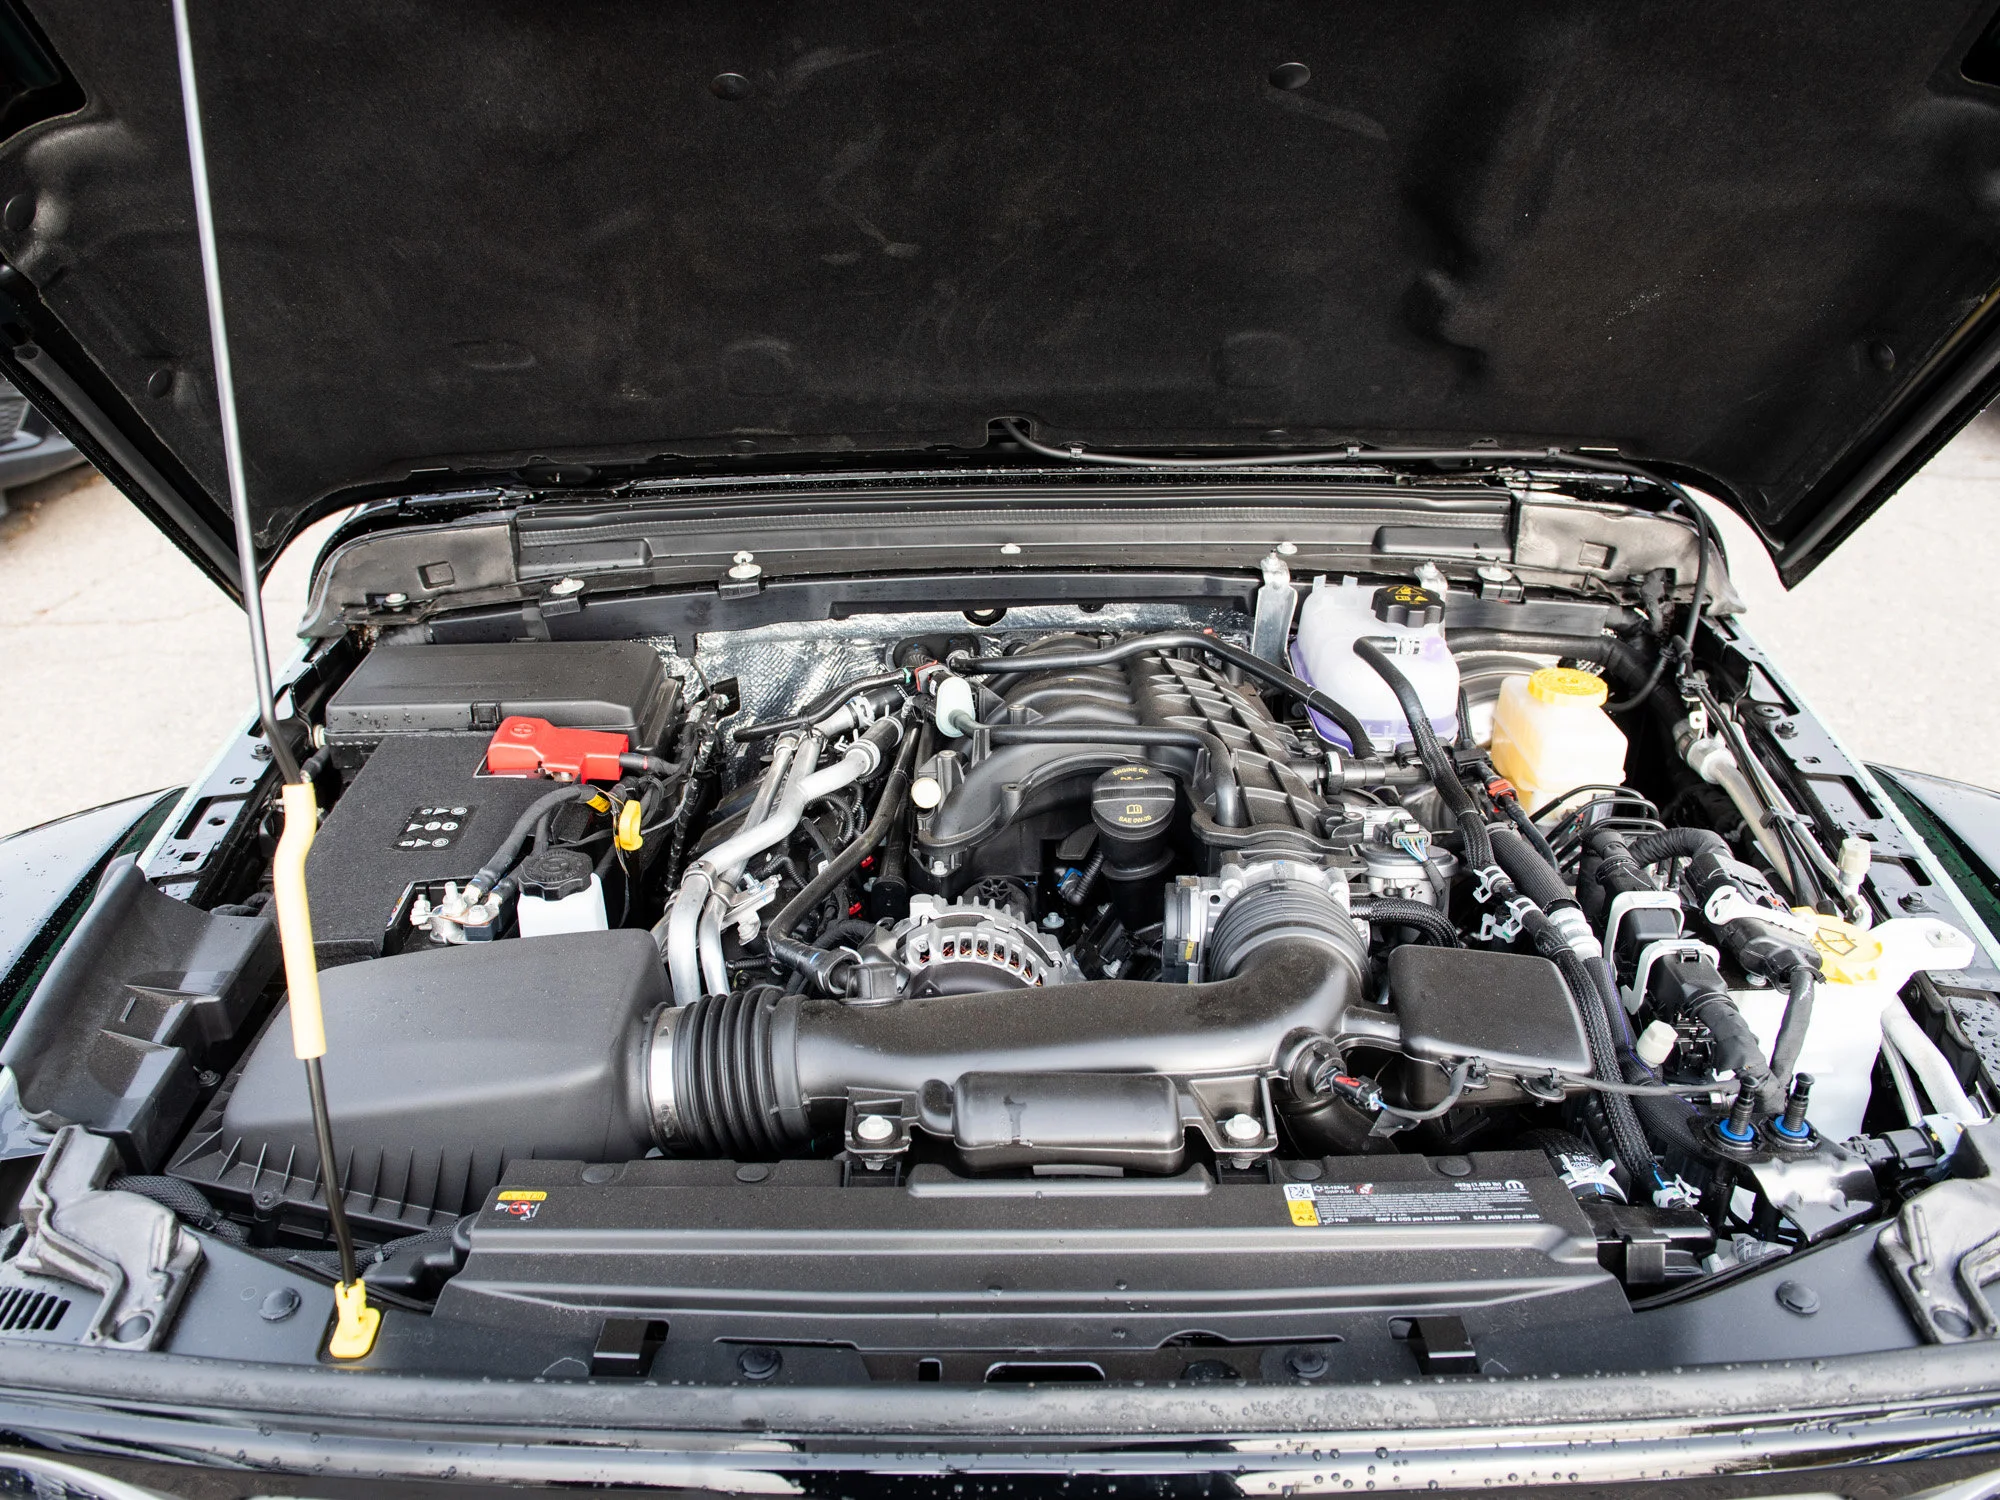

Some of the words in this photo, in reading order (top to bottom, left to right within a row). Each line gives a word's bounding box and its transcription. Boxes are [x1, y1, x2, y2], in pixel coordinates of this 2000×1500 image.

[1112, 767, 1138, 776] ENGINE
[1138, 767, 1149, 775] OIL
[1118, 815, 1133, 823] SAE
[1132, 815, 1152, 824] 0W-20
